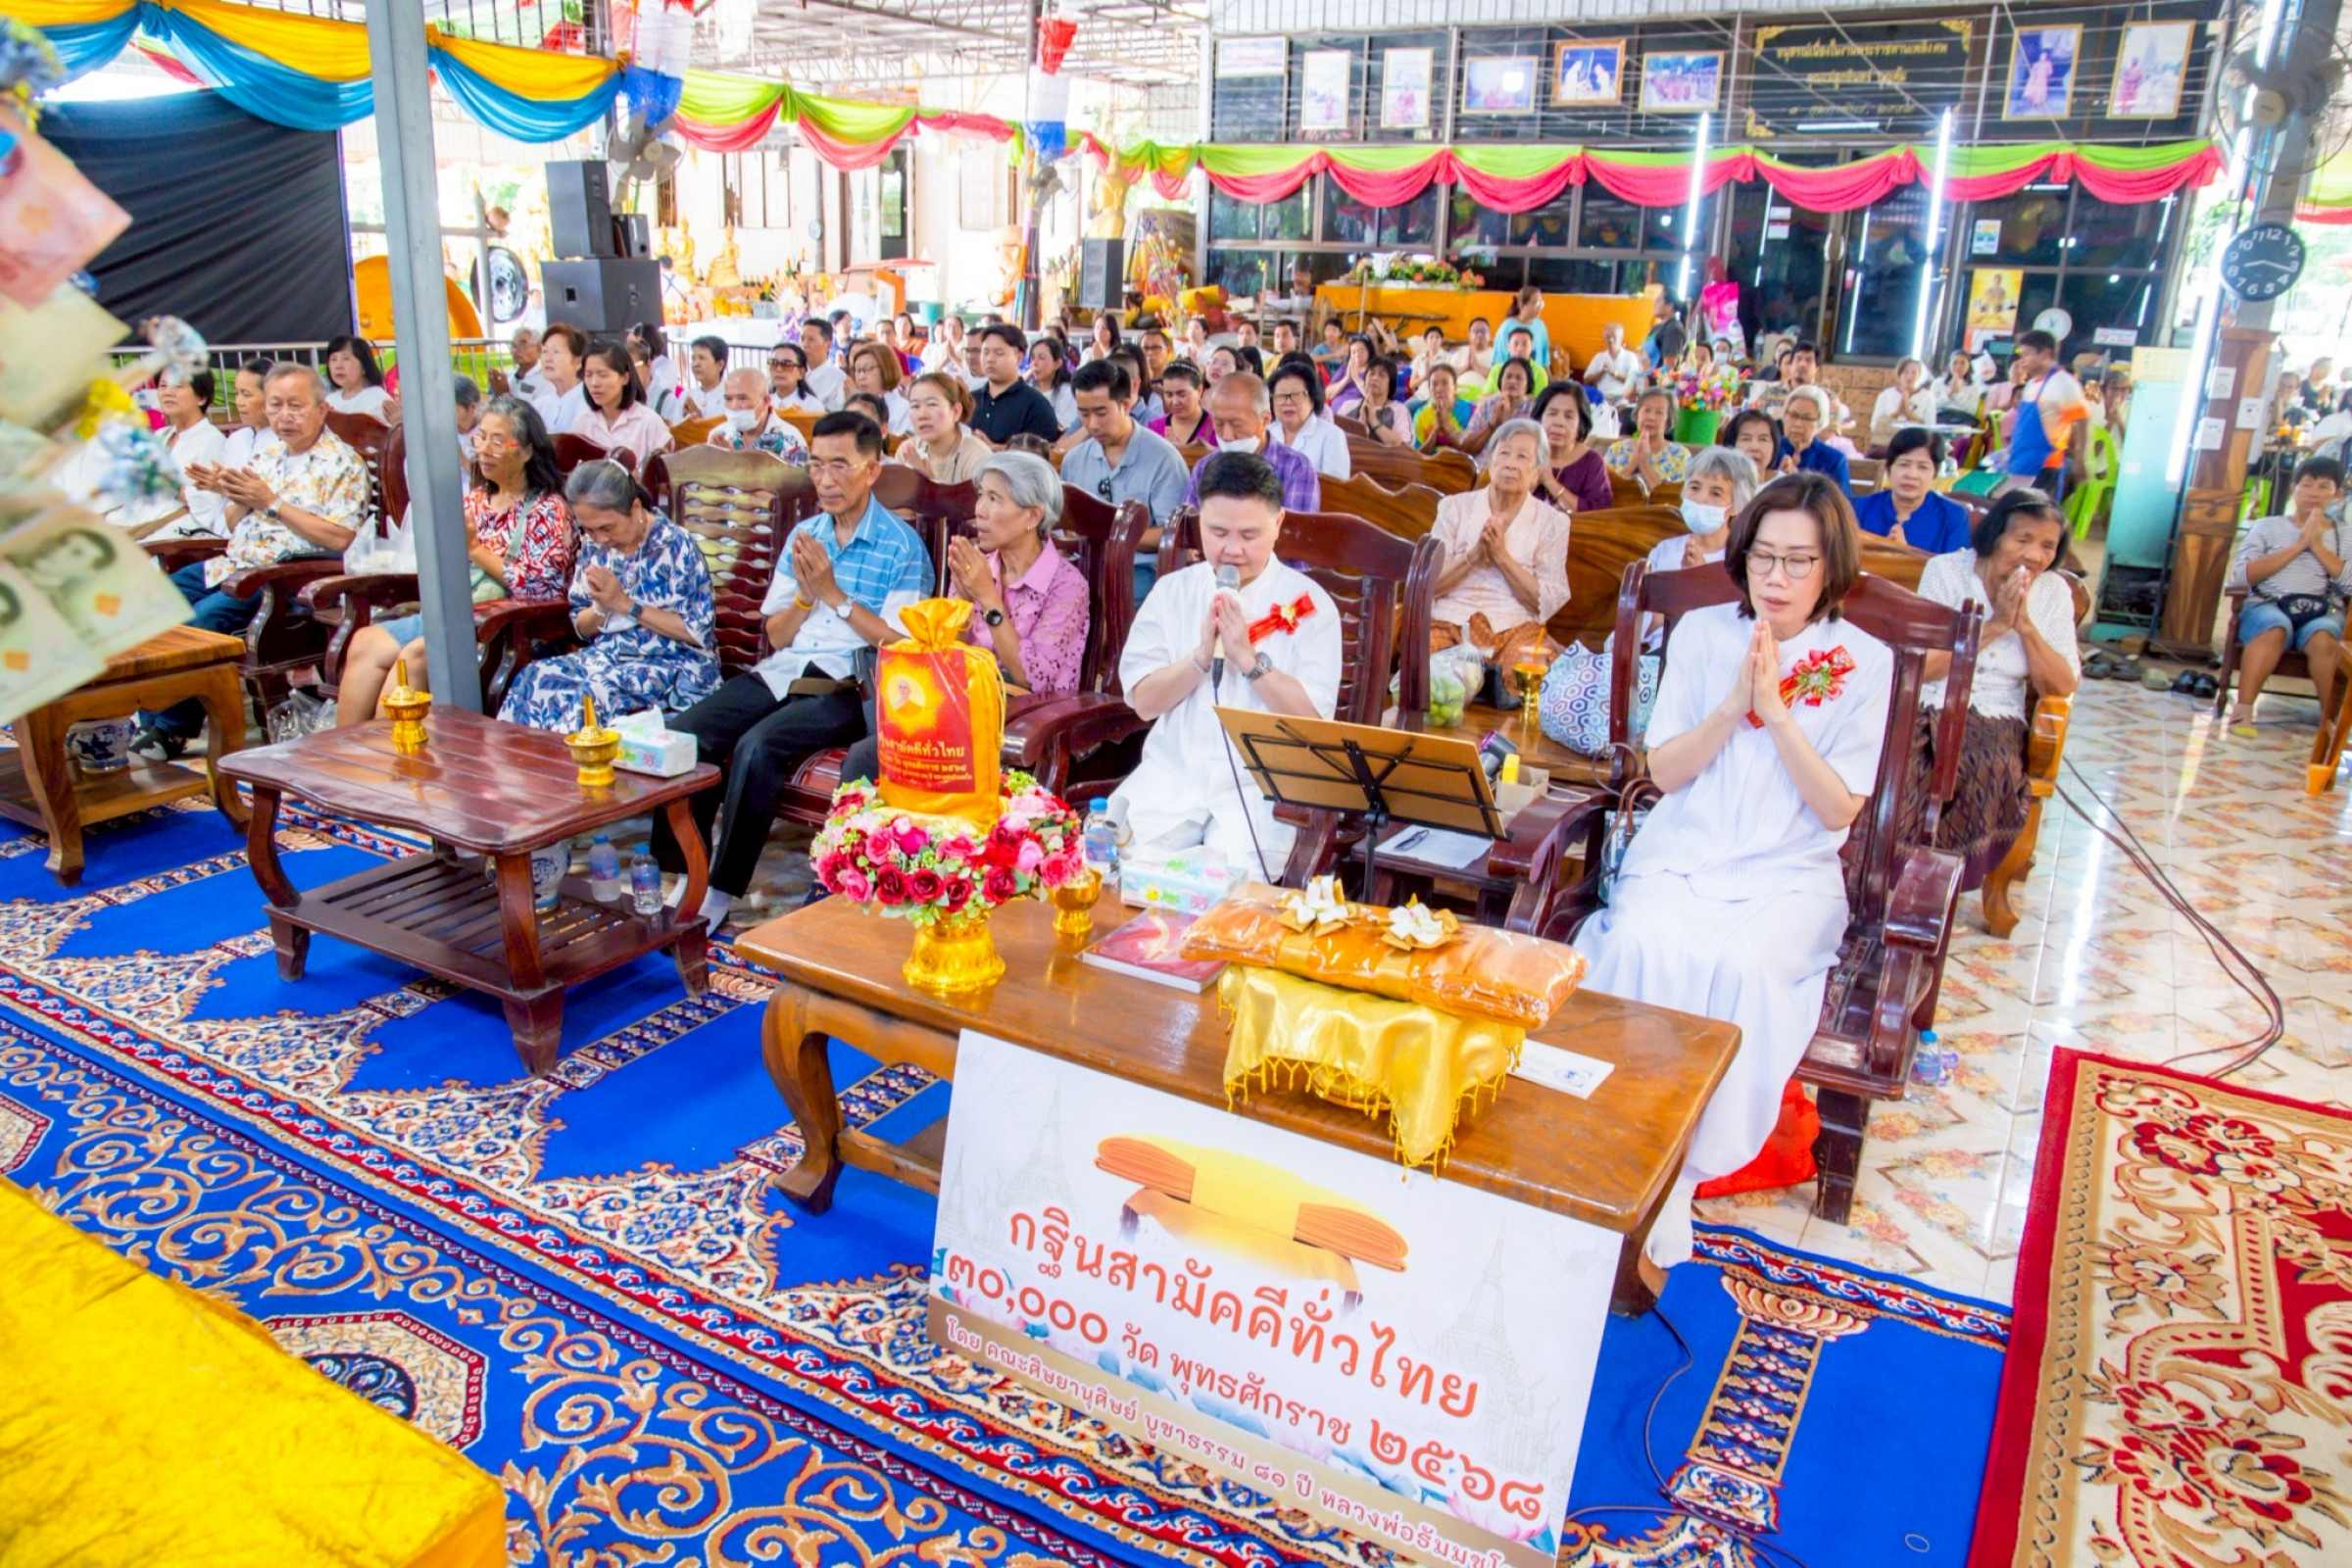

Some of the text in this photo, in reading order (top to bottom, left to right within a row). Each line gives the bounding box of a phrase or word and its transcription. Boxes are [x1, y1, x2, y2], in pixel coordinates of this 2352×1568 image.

[2253, 230, 2265, 242] 11
[2266, 227, 2282, 241] 12
[2284, 234, 2291, 245] 1
[2238, 239, 2253, 251] 10
[2287, 245, 2300, 257] 2
[2229, 251, 2239, 262] 9
[2229, 266, 2239, 276] 8
[2236, 277, 2246, 287] 7
[2277, 274, 2289, 285] 4
[2247, 284, 2258, 295] 6
[2264, 282, 2276, 294] 5
[1009, 1205, 1478, 1419] กฐินสามัคคีทั่วไทย
[948, 1253, 1544, 1521] ๓๐,๐๐๐ วัด พุทธศักราช ๒๕๖๘
[946, 1314, 981, 1350] โดย
[987, 1342, 1137, 1422] คณะศิษยานุศิษย์
[1145, 1413, 1245, 1470] บูชาธรรม
[1253, 1463, 1286, 1488] ๘๑
[1296, 1472, 1312, 1498] ปี
